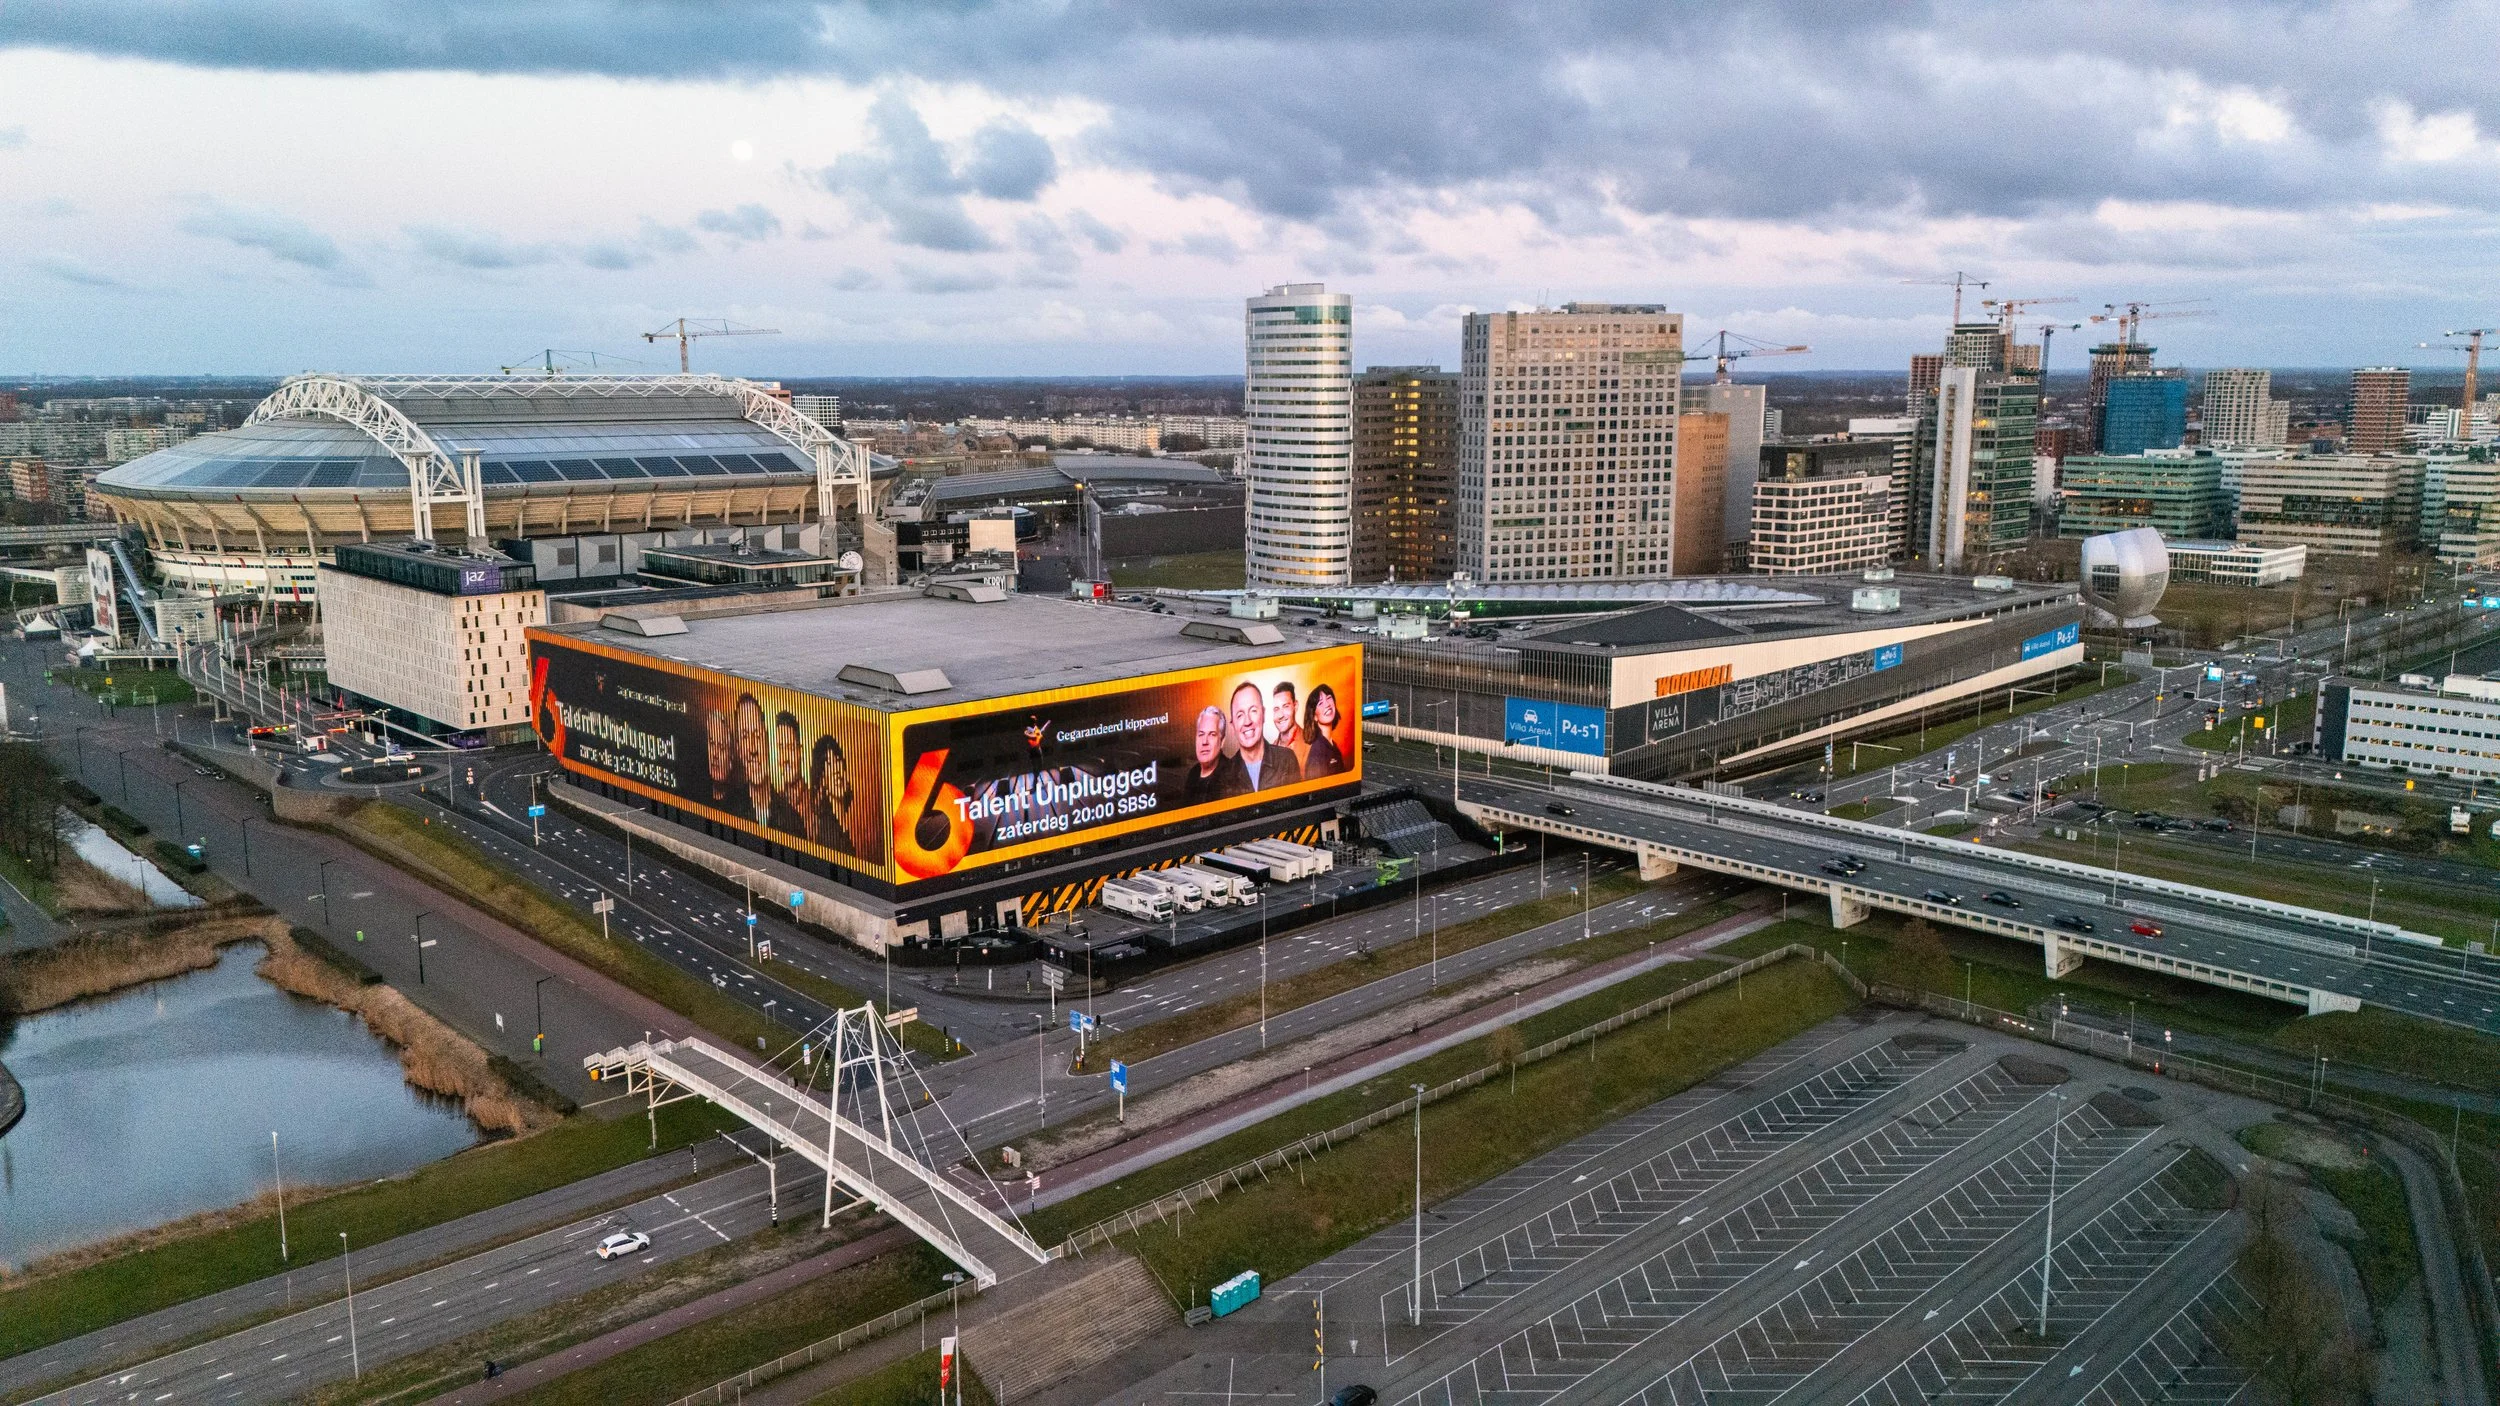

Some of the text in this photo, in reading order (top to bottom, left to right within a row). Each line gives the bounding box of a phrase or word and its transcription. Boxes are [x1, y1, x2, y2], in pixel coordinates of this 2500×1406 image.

[465, 570, 486, 586] jaz
[1656, 663, 1733, 697] WOONMALL
[1654, 704, 1679, 719] VILLA
[1056, 712, 1169, 742] Gegarandeerd kippenvel
[1509, 722, 1552, 736] Villa ArenA
[1562, 719, 1589, 738] P4-5
[1652, 716, 1680, 731] ARENA
[954, 760, 1157, 822] Talent Unplugged
[997, 792, 1157, 841] zaterdag 20:00 SBS6
